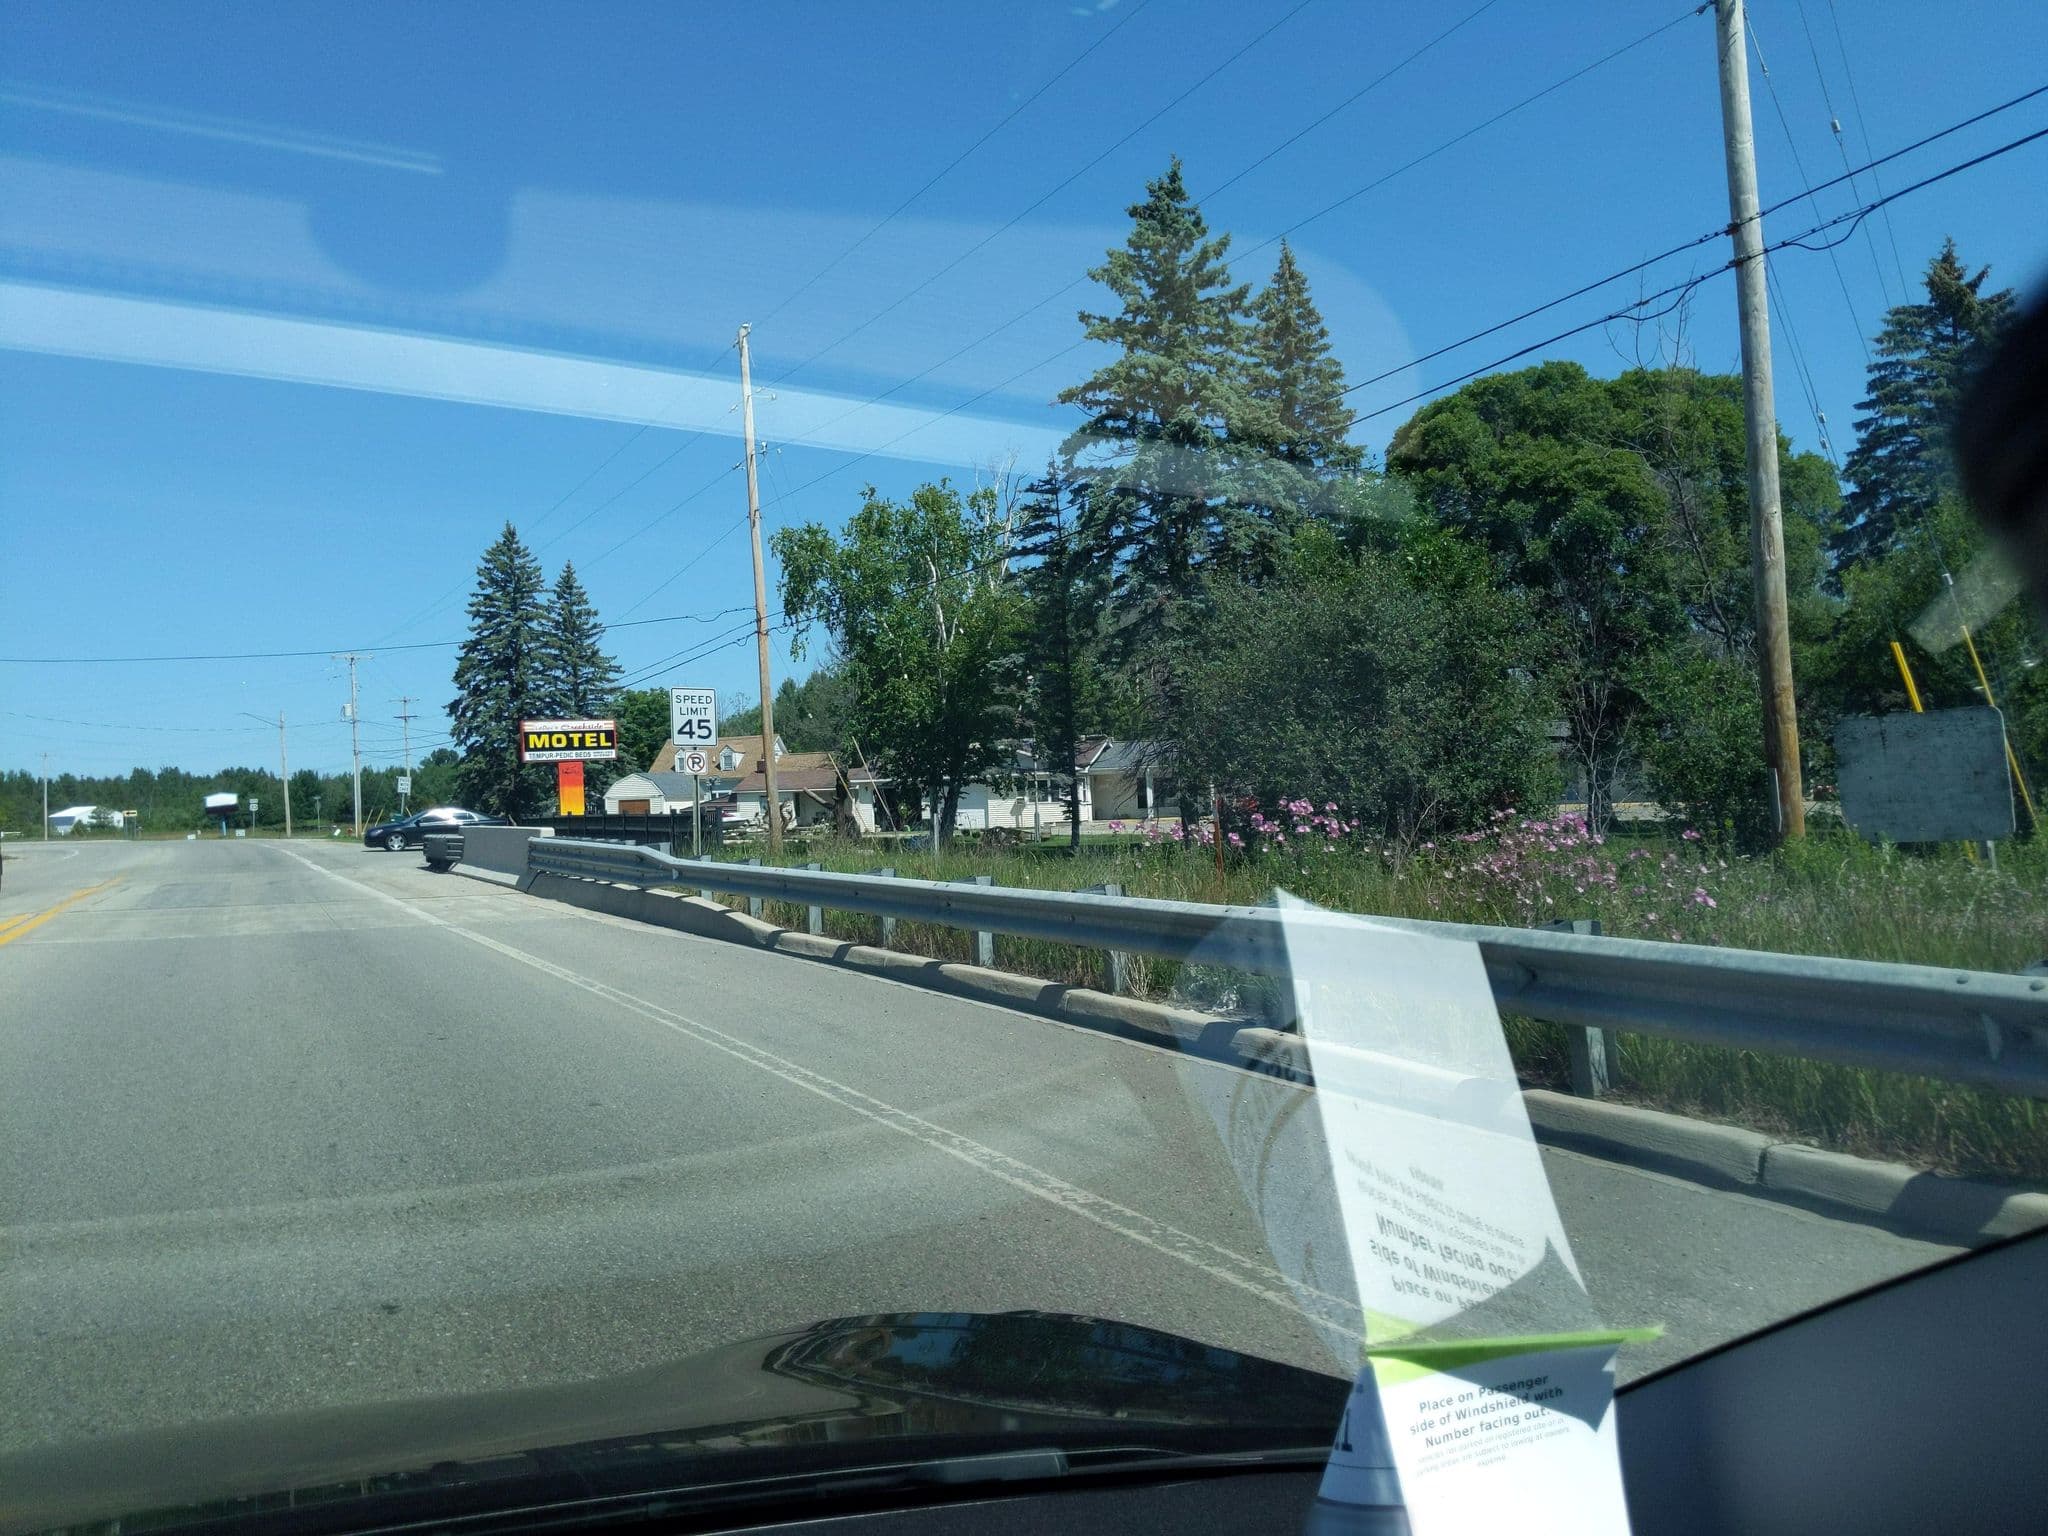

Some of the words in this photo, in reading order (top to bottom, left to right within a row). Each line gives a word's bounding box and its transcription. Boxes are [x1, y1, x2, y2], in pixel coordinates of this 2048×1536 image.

[675, 694, 713, 704] SPEED
[679, 706, 709, 716] LIMIT
[677, 718, 712, 740] 45
[529, 733, 612, 749] MOTEL
[1419, 1397, 1454, 1414] Place
[1458, 1391, 1474, 1404] on
[1478, 1375, 1549, 1399] Passenger
[1409, 1420, 1435, 1436] side
[1439, 1413, 1451, 1426] of
[1454, 1394, 1529, 1421] Windshield
[1533, 1387, 1563, 1402] with
[1424, 1425, 1476, 1448] Number
[1479, 1412, 1520, 1433] facing
[1523, 1406, 1551, 1421] out.
